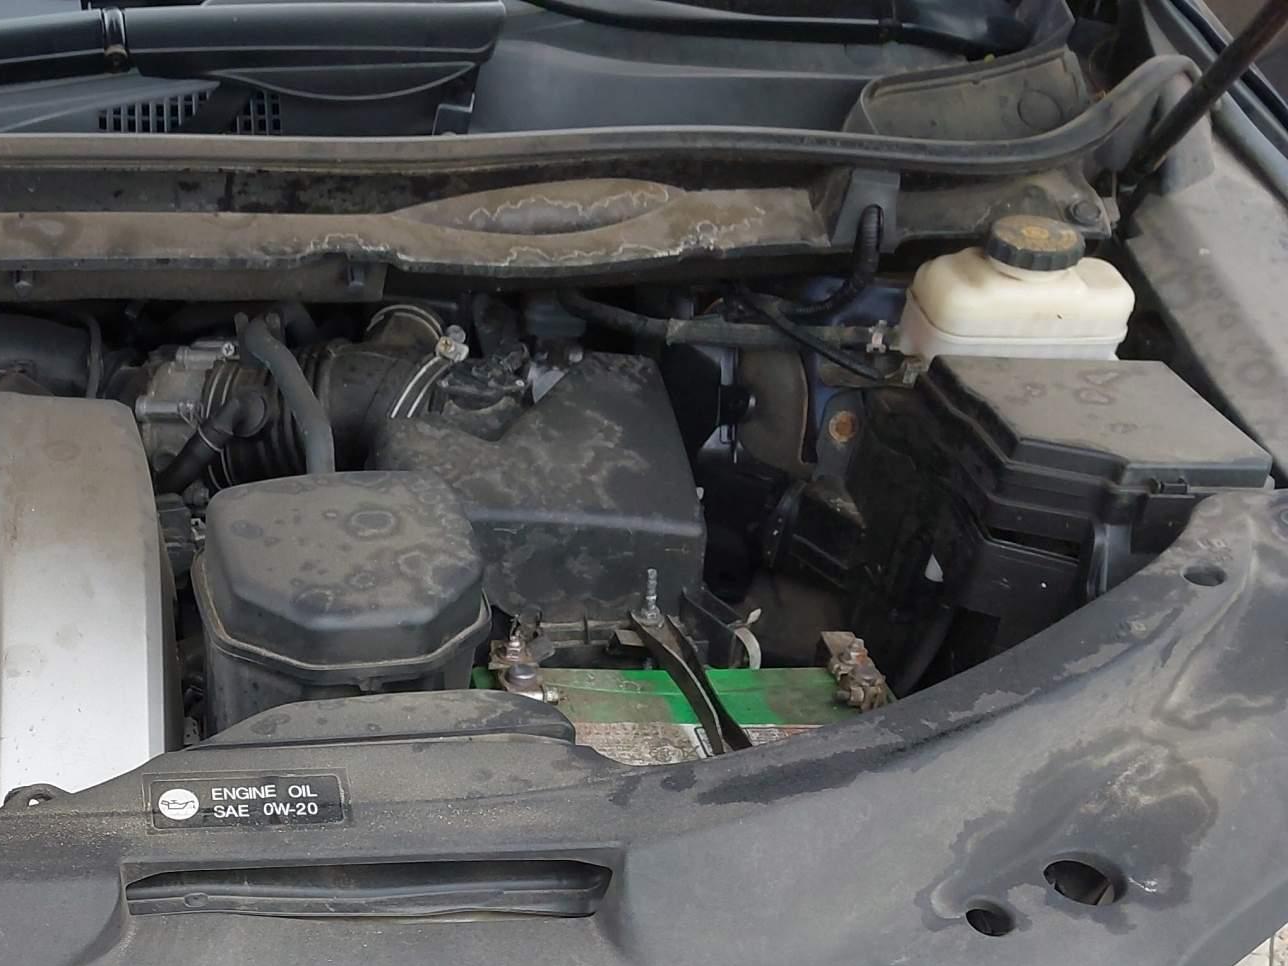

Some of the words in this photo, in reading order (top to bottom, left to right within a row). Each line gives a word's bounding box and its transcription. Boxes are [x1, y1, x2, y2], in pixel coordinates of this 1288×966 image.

[211, 784, 276, 800] ENGINE
[287, 784, 318, 798] OIL
[213, 805, 250, 818] SAE
[263, 802, 318, 816] 0W-20
